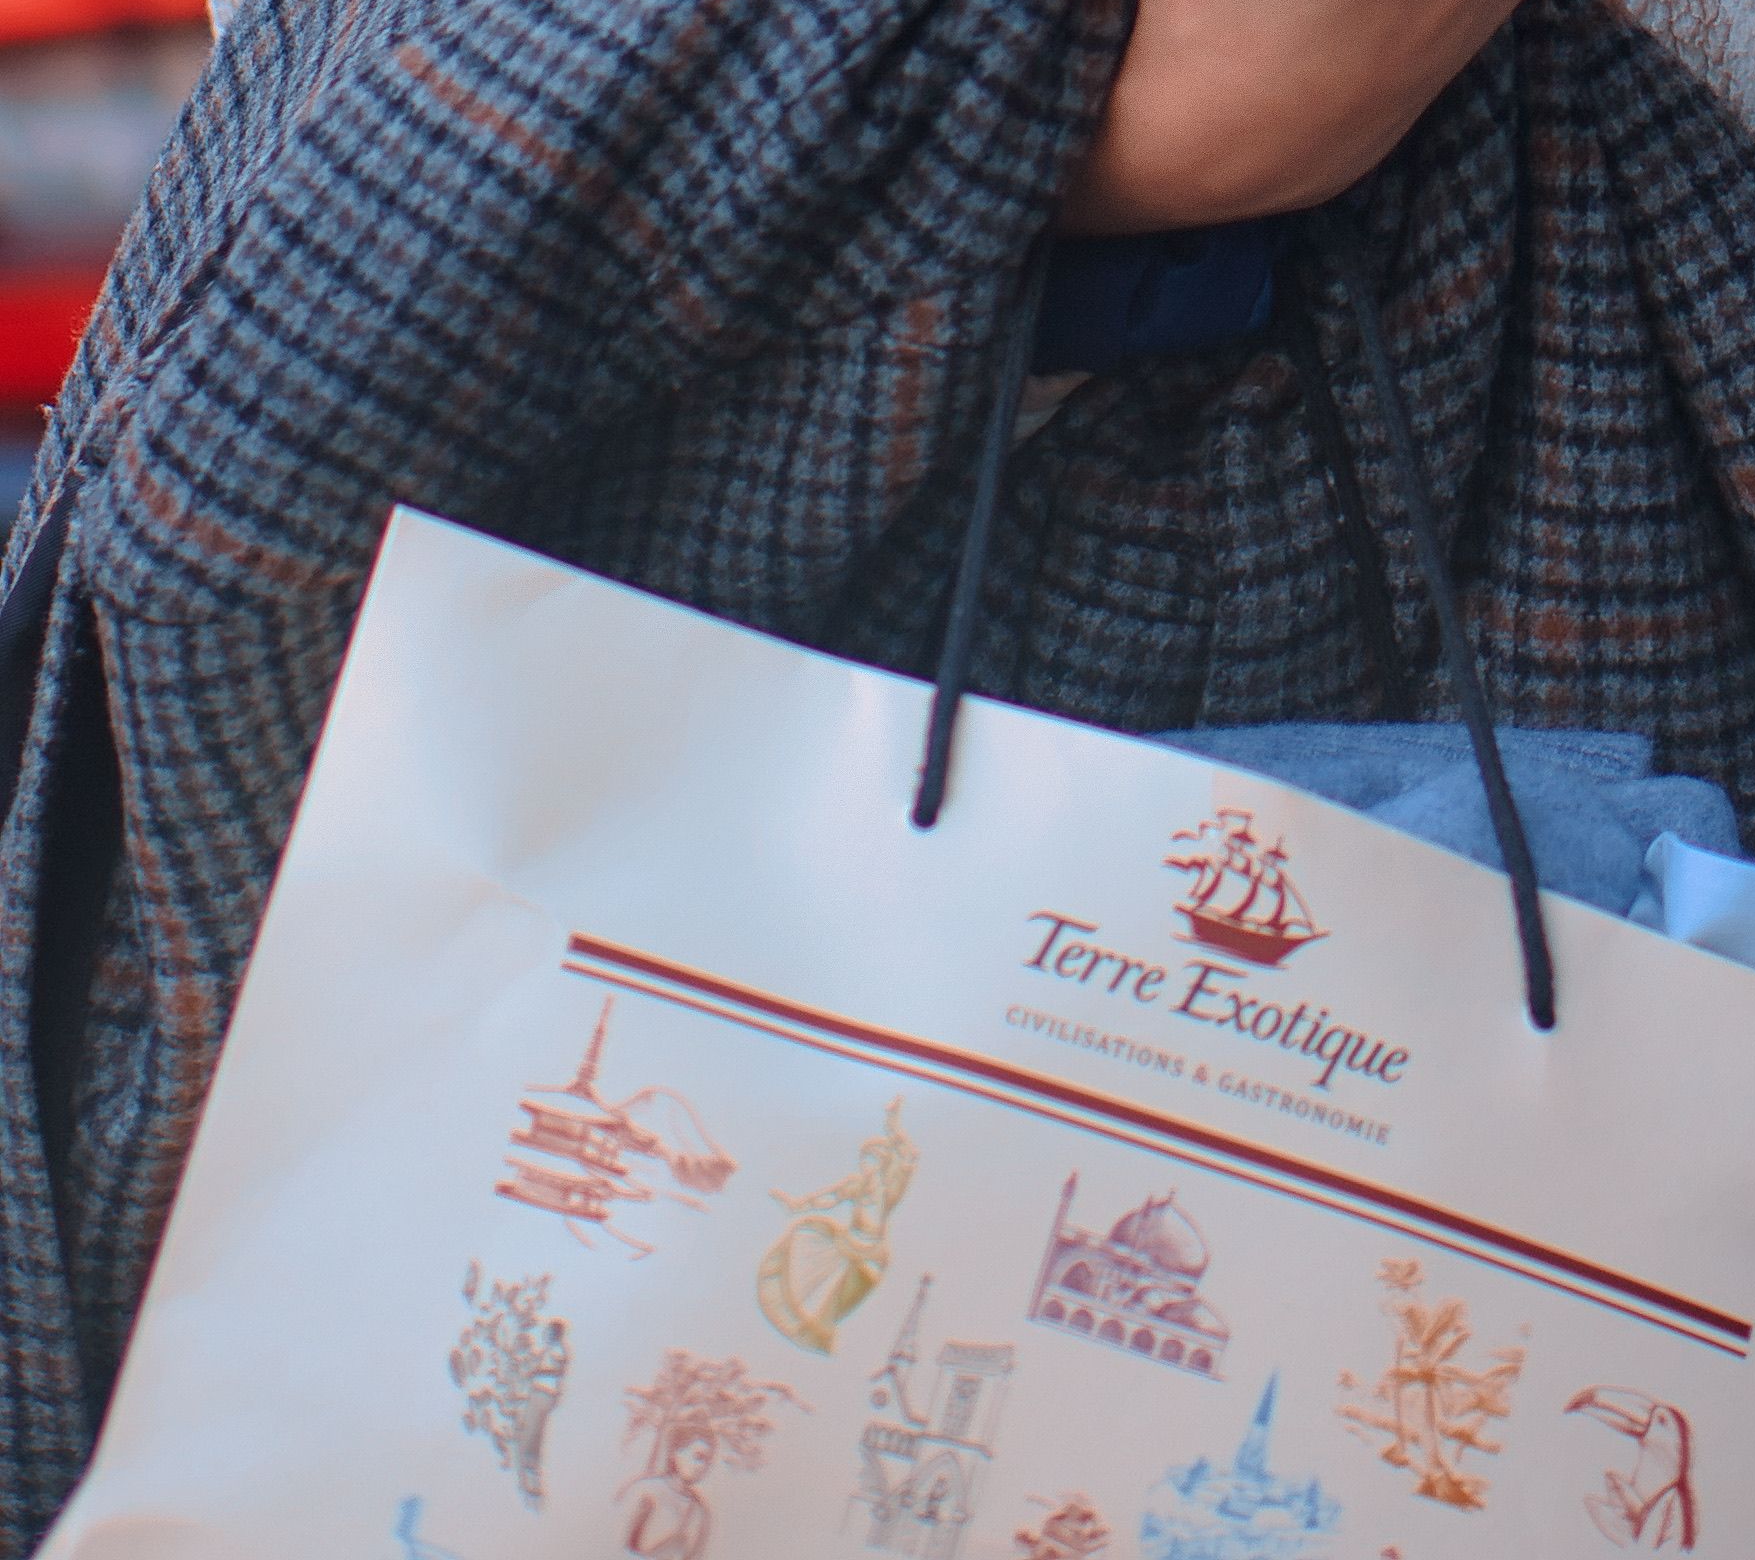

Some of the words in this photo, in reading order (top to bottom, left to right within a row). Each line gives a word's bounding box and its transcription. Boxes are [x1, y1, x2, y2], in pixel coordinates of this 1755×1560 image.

[1006, 1004, 1186, 1077] CIVILISATIONS
[1192, 1062, 1209, 1085] &
[1218, 1071, 1392, 1146] GASTRONOMIE
[1023, 910, 1168, 1003] Terre
[1169, 959, 1410, 1094] Exotique
